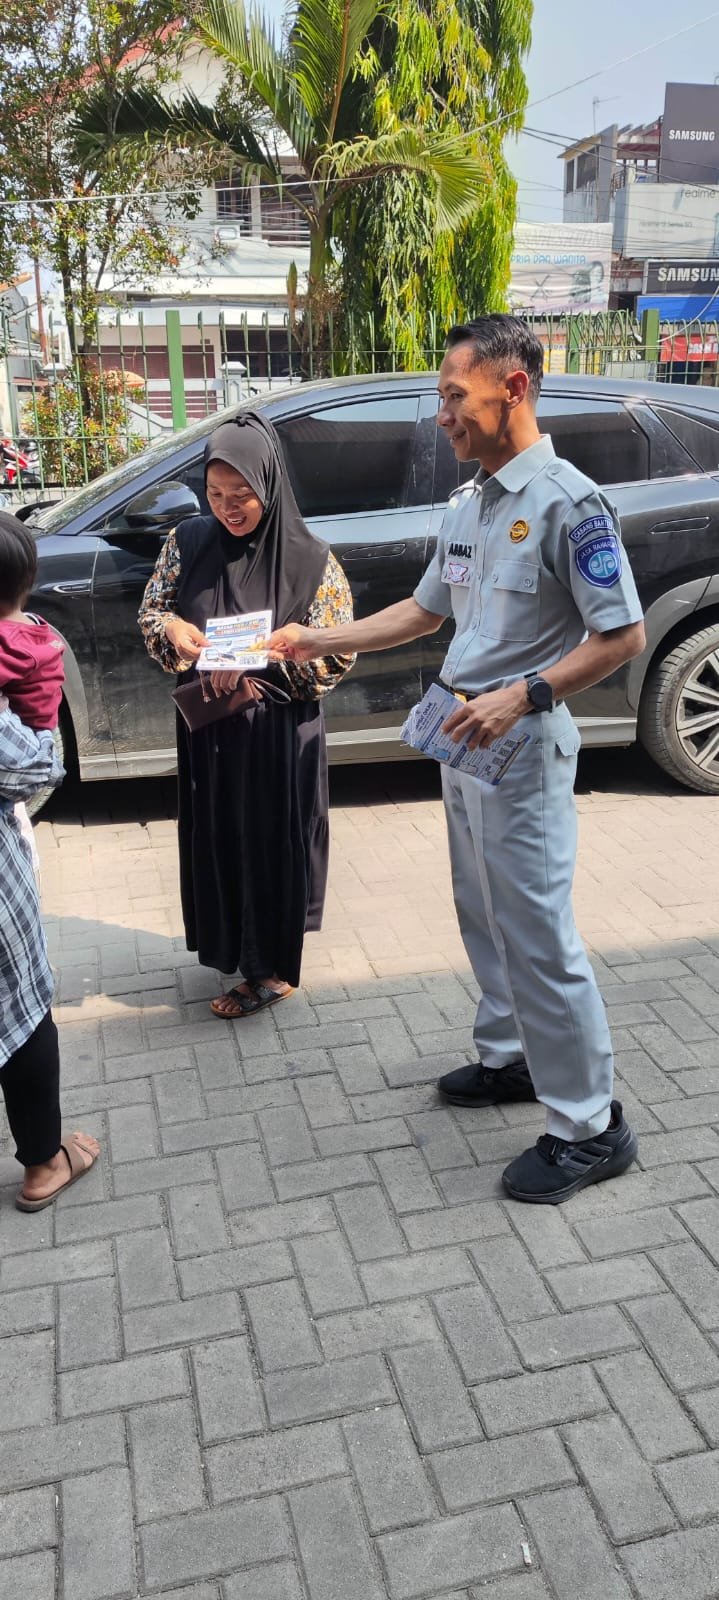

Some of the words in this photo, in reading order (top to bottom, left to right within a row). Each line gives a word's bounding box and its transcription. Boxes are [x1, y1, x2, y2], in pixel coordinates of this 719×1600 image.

[669, 129, 715, 141] SAMSUNG
[680, 188, 716, 198] realme
[511, 255, 530, 264] PRIA
